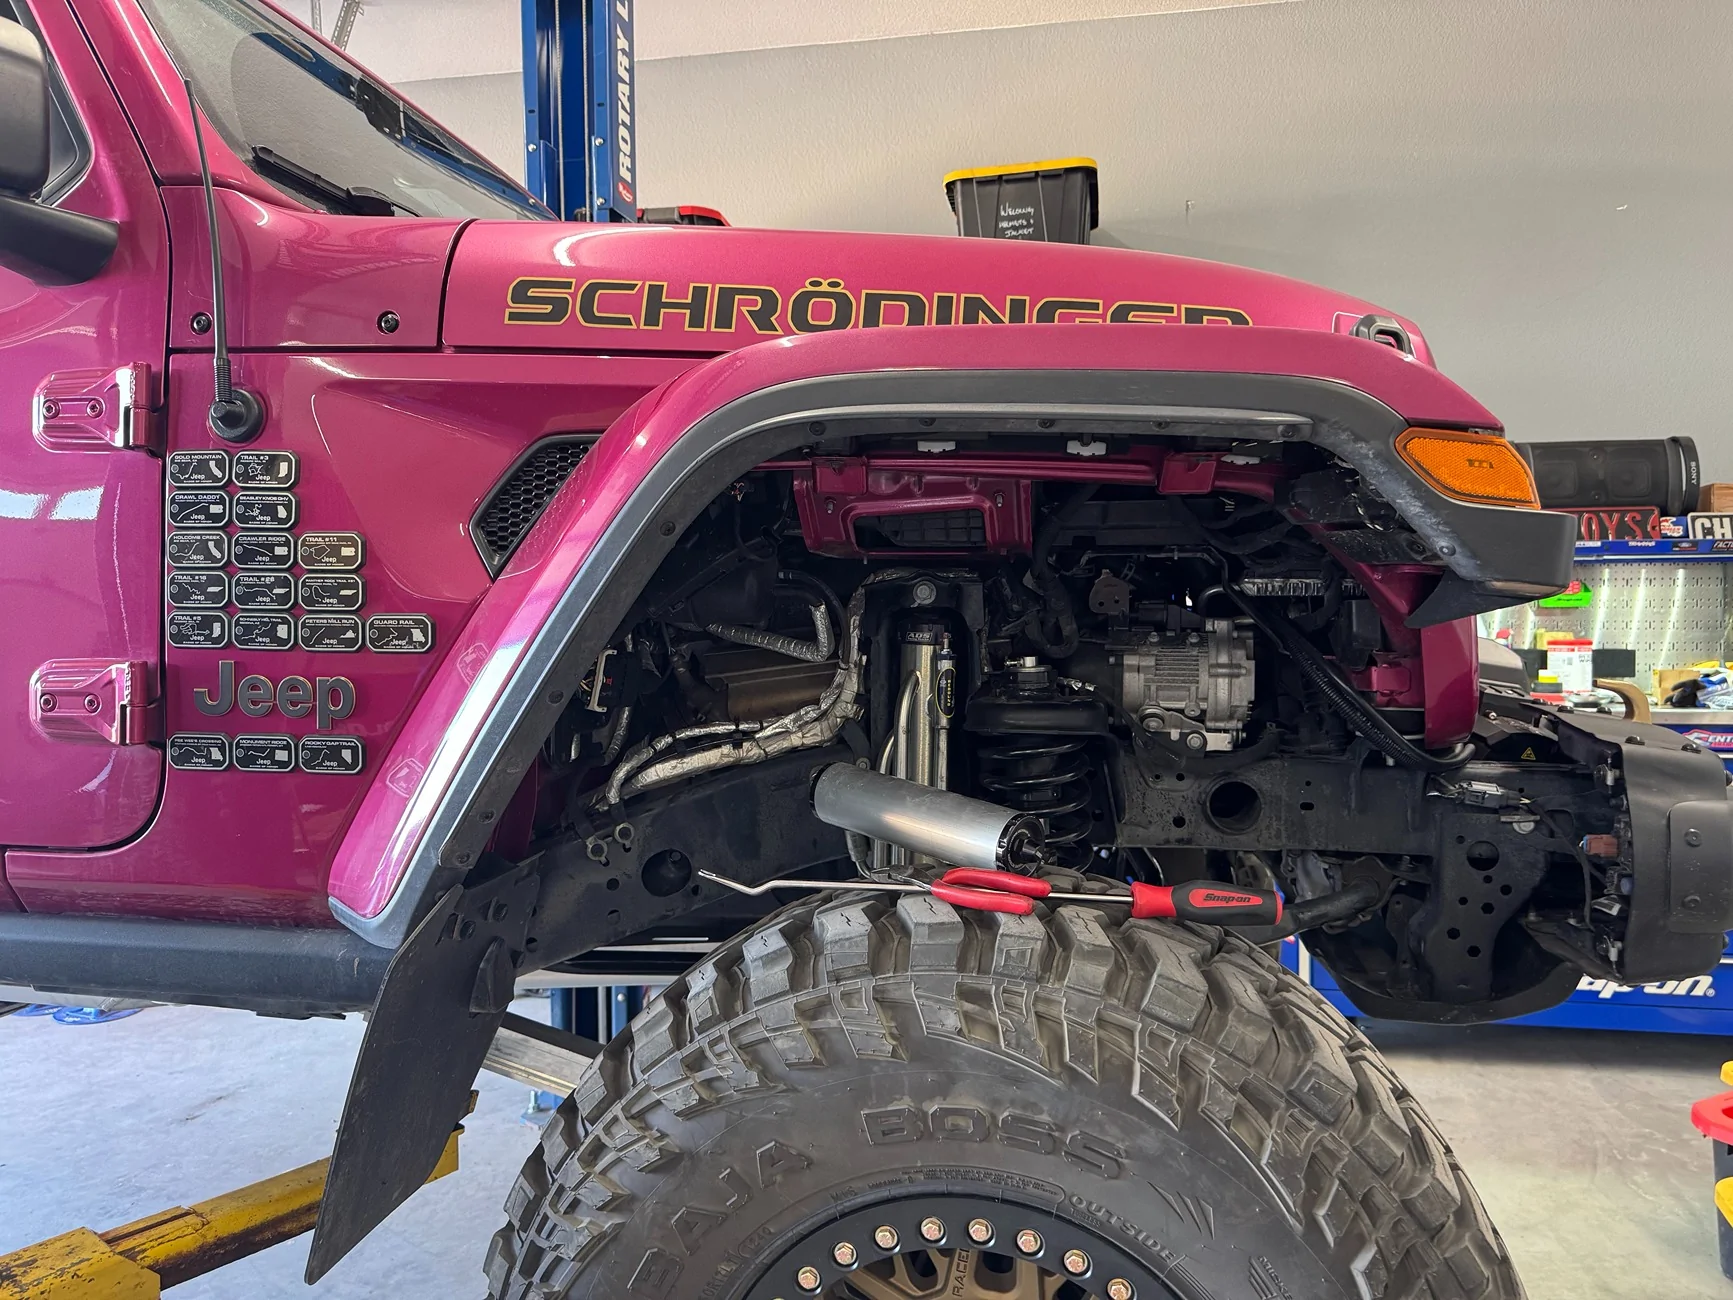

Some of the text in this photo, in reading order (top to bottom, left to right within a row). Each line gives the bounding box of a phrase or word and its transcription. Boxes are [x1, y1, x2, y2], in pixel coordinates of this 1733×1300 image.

[616, 23, 632, 184] ROTARY
[194, 660, 356, 730] Jeep
[1203, 893, 1251, 903] Snap-on
[627, 1104, 1128, 1300] BAJA BOSS
[1069, 1195, 1176, 1263] OUTSIDE
